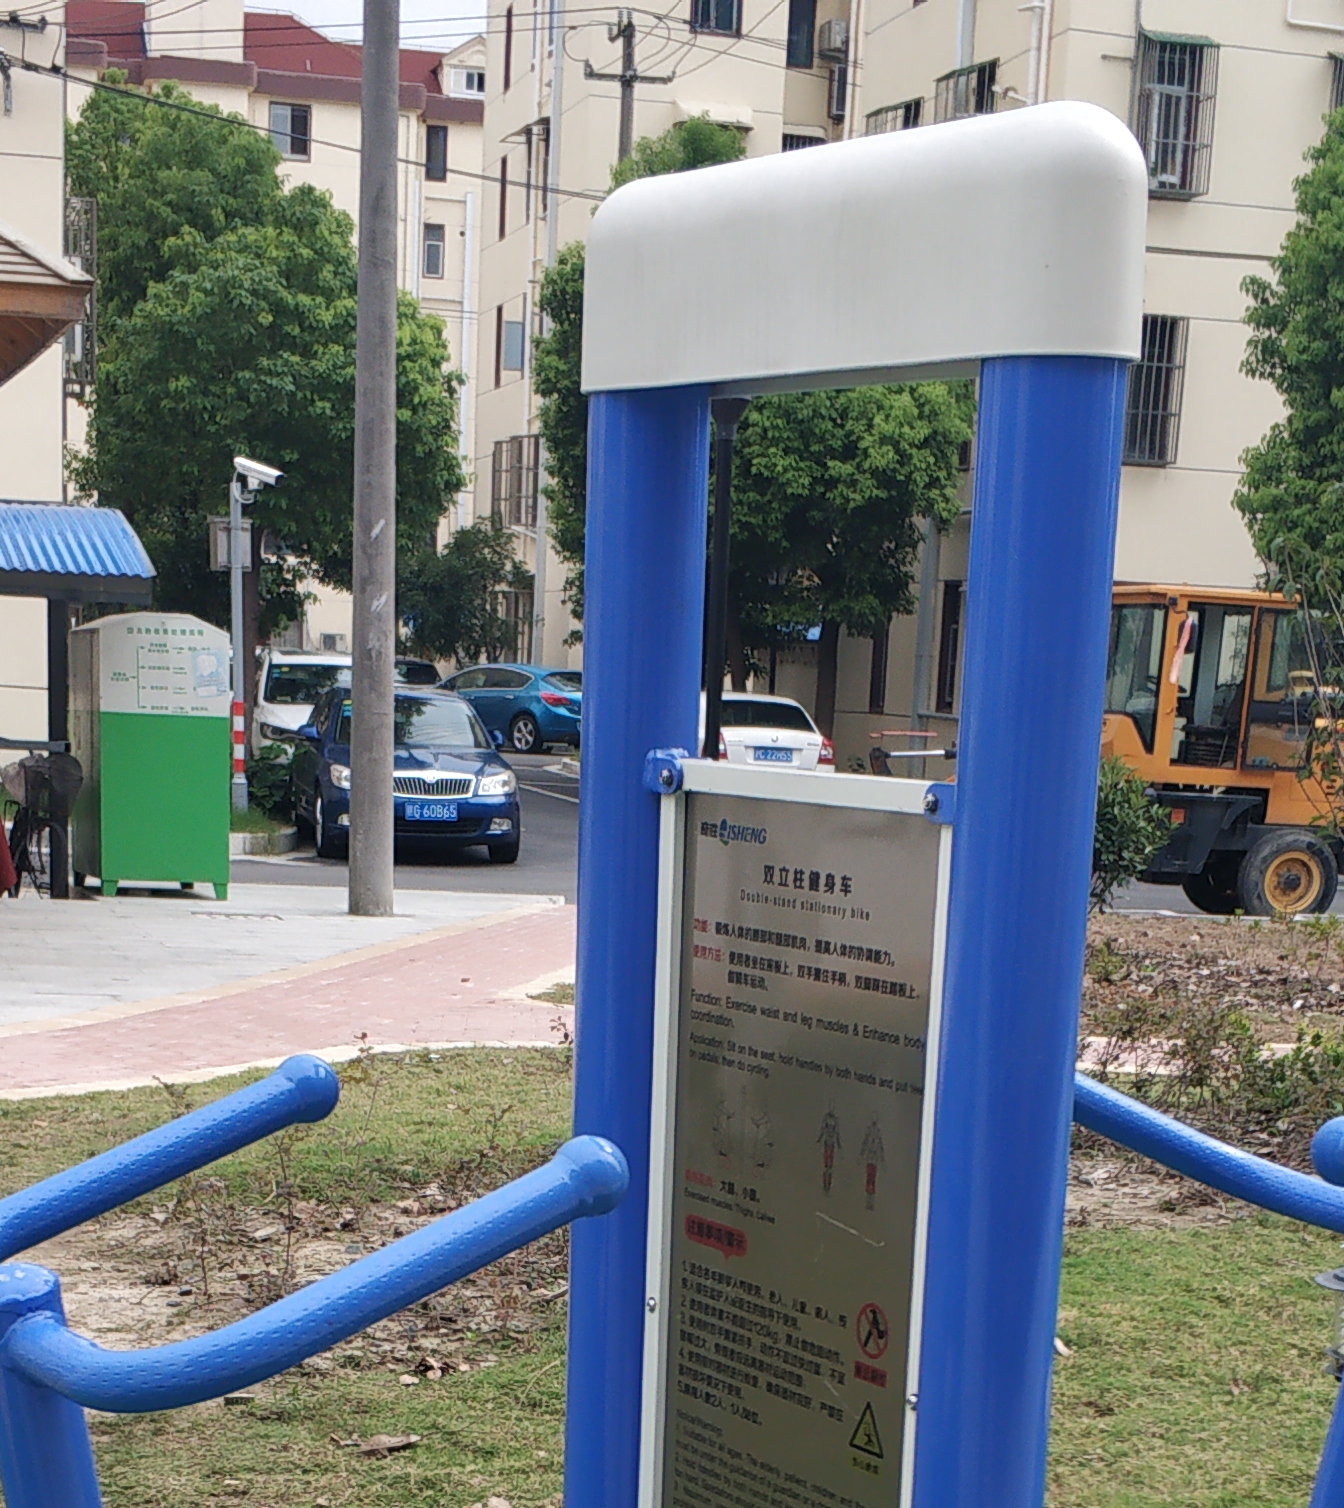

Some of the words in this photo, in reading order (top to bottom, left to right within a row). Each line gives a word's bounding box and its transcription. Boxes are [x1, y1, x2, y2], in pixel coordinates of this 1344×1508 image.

[762, 864, 853, 897] 双立柱健身车
[801, 900, 847, 919] stationary
[850, 907, 870, 921] bike
[782, 1011, 798, 1023] and
[800, 1011, 813, 1030] leg
